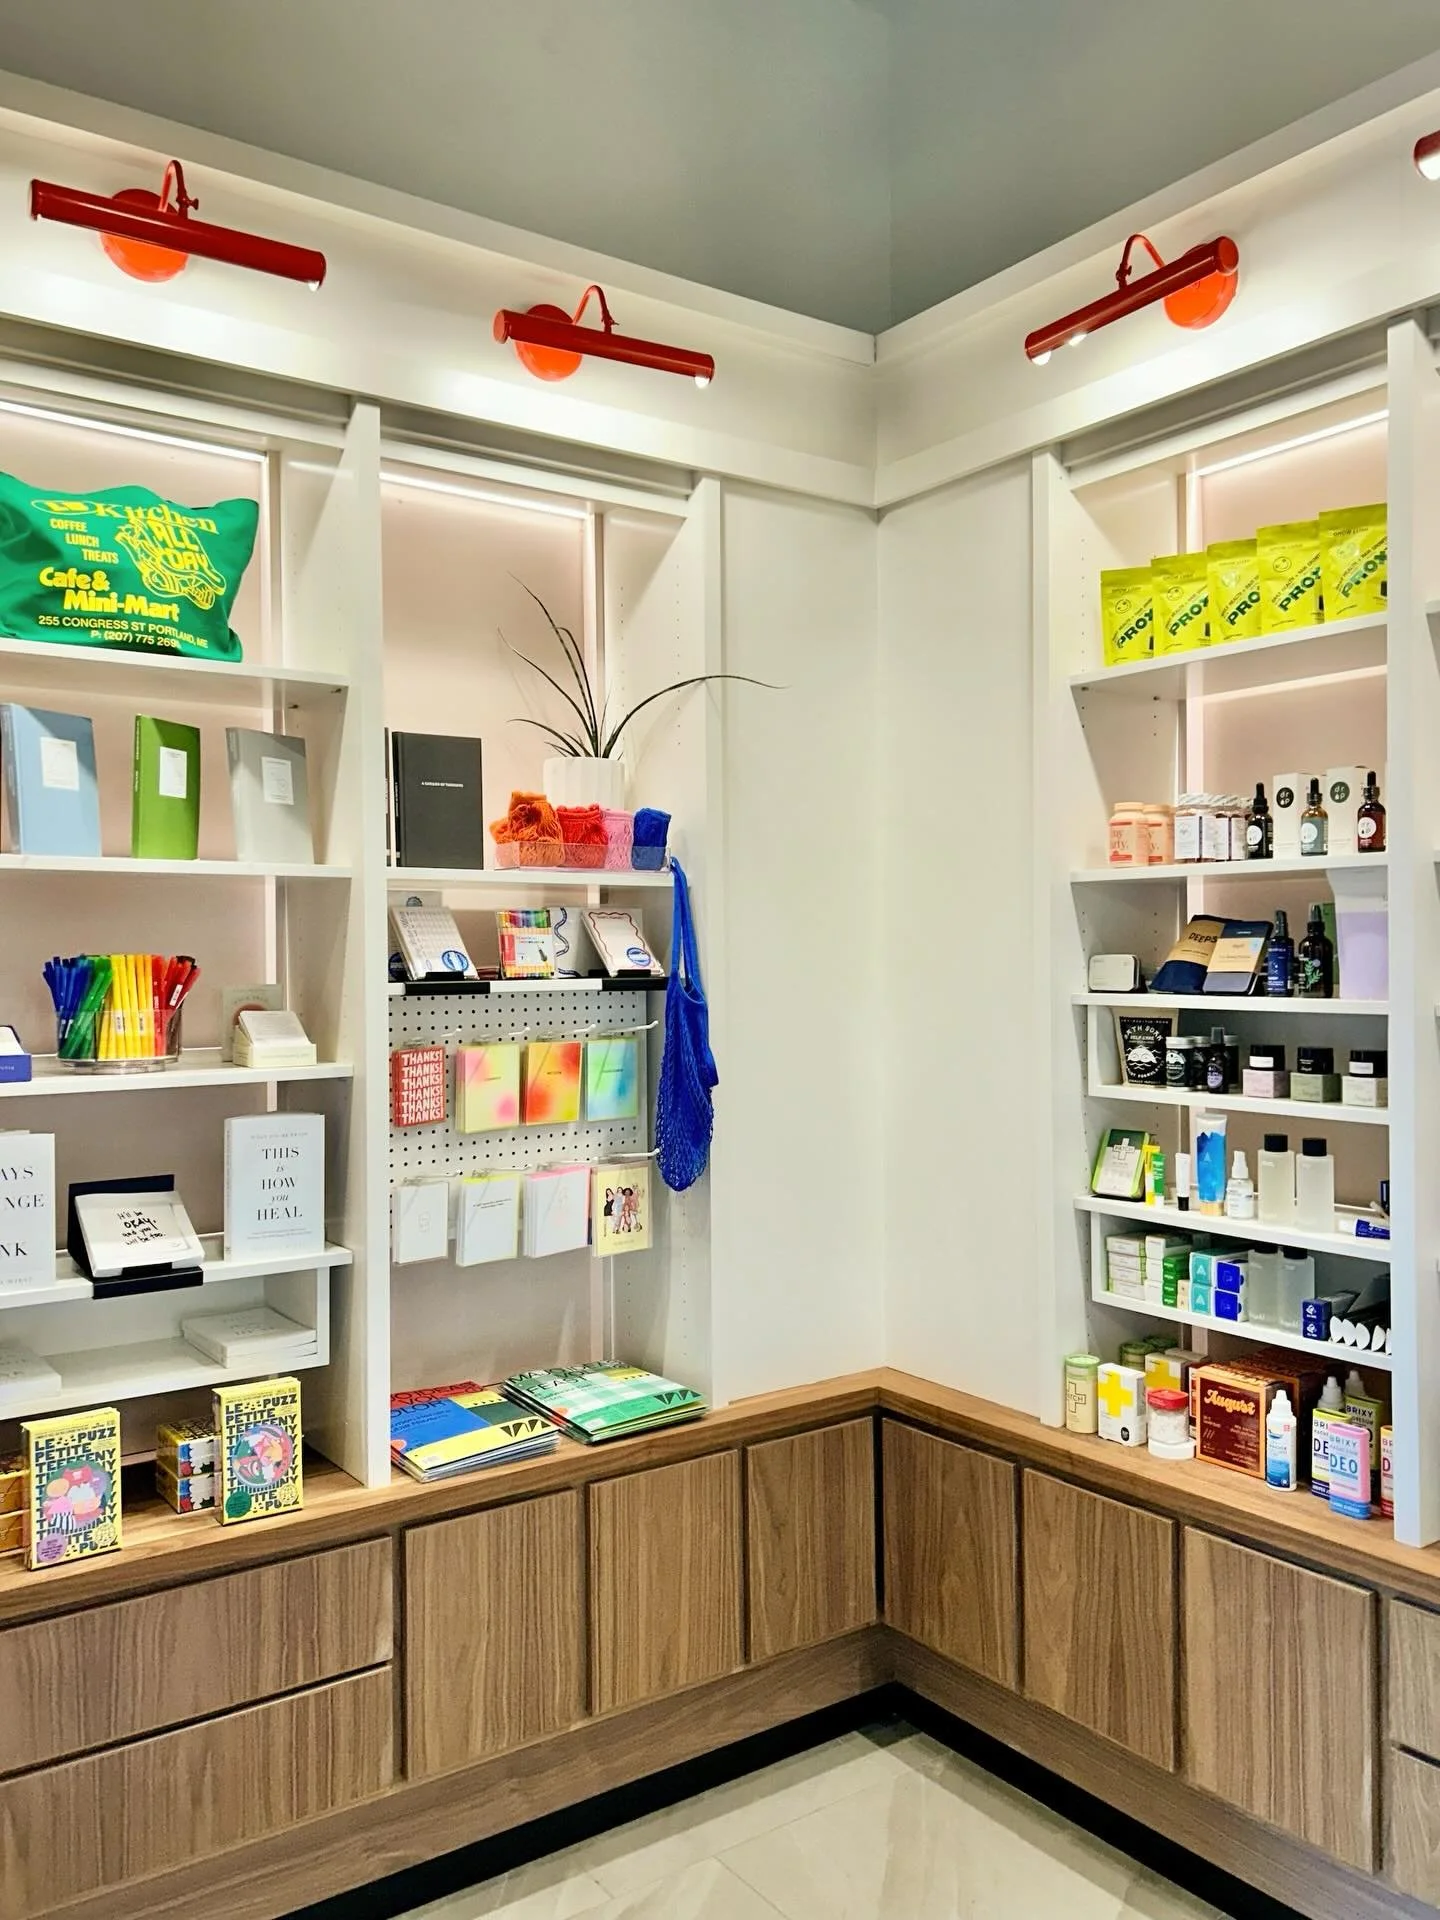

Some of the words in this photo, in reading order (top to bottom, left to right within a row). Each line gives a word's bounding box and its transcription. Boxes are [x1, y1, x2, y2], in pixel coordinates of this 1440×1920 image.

[50, 518, 88, 532] COFFEE
[65, 533, 100, 548] LUNCH
[149, 519, 200, 551] ALL
[82, 548, 119, 564] TREATS
[161, 549, 210, 570] DAY
[63, 589, 180, 622] Mini-Mart
[1226, 586, 1260, 626] PRO
[39, 615, 60, 626] 255
[62, 616, 129, 630] CONGRESS
[130, 621, 146, 632] ST
[103, 631, 133, 643] (207)
[135, 634, 155, 645] 775
[402, 1049, 444, 1066] THANKS!
[402, 1062, 444, 1078] THANKS!
[402, 1073, 444, 1090] THANKS!
[402, 1085, 444, 1102] THANKS!
[402, 1096, 444, 1114] THANKS!
[402, 1106, 444, 1124] THANKS!
[262, 1147, 299, 1159] THIS
[276, 1163, 284, 1172] is
[262, 1177, 295, 1190] HOW
[257, 1206, 302, 1221] HEAL
[226, 1403, 243, 1415] LE
[263, 1394, 297, 1408] PUZZ
[1204, 1389, 1256, 1415] August
[226, 1408, 275, 1425] PETITE
[1346, 1405, 1373, 1418] BRIXY
[35, 1438, 55, 1451] LE
[78, 1426, 116, 1443] PUZZ
[1314, 1438, 1329, 1455] DE
[1329, 1434, 1357, 1448] BRIXY
[35, 1443, 91, 1462] PETITE
[1330, 1454, 1358, 1474] DEO
